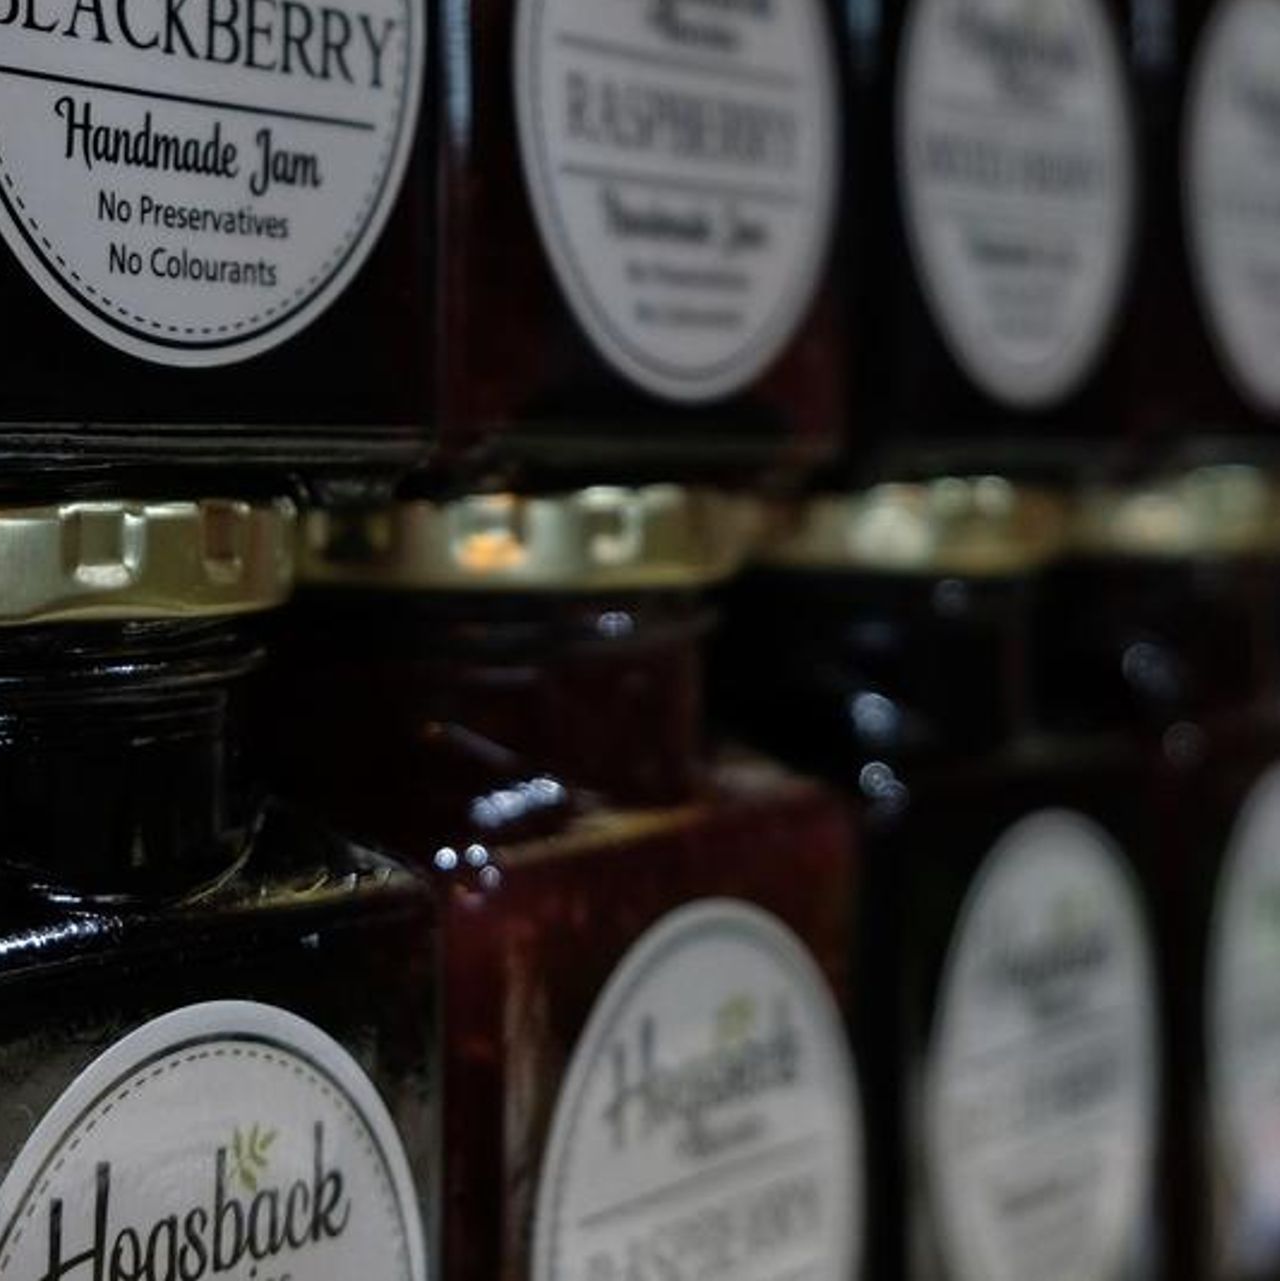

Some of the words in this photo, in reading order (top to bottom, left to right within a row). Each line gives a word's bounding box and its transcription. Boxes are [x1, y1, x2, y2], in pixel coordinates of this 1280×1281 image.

[54, 96, 239, 178] Handmade
[249, 127, 324, 197] Jam
[98, 190, 132, 224] No
[140, 195, 289, 239] Preservatives
[109, 242, 142, 276] No
[150, 247, 277, 288] Colourants
